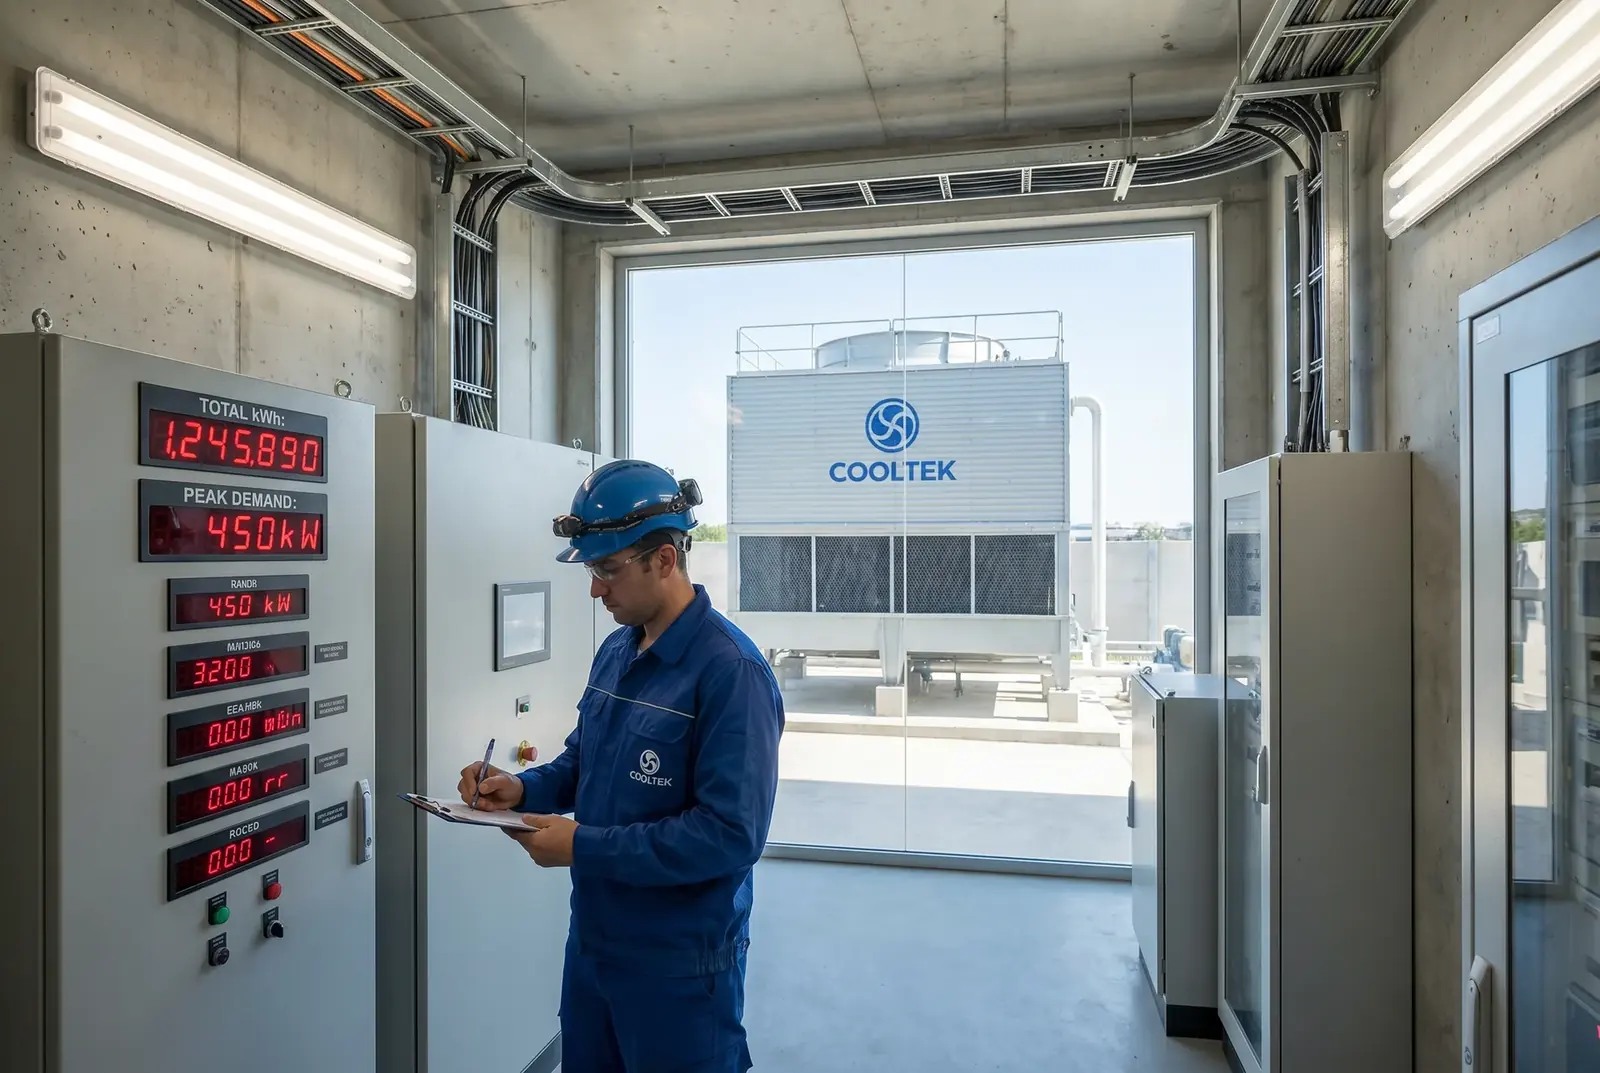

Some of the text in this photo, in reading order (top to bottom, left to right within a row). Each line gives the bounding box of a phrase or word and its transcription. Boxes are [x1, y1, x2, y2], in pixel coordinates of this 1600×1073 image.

[199, 397, 285, 426] TOTAL kWh:
[829, 460, 957, 483] COOLTEK
[184, 487, 297, 509] PEAK DEMAND:
[209, 594, 251, 617] 450
[193, 656, 251, 685] 3200
[629, 770, 672, 786] COOLTEK
[229, 821, 260, 839] ROCED
